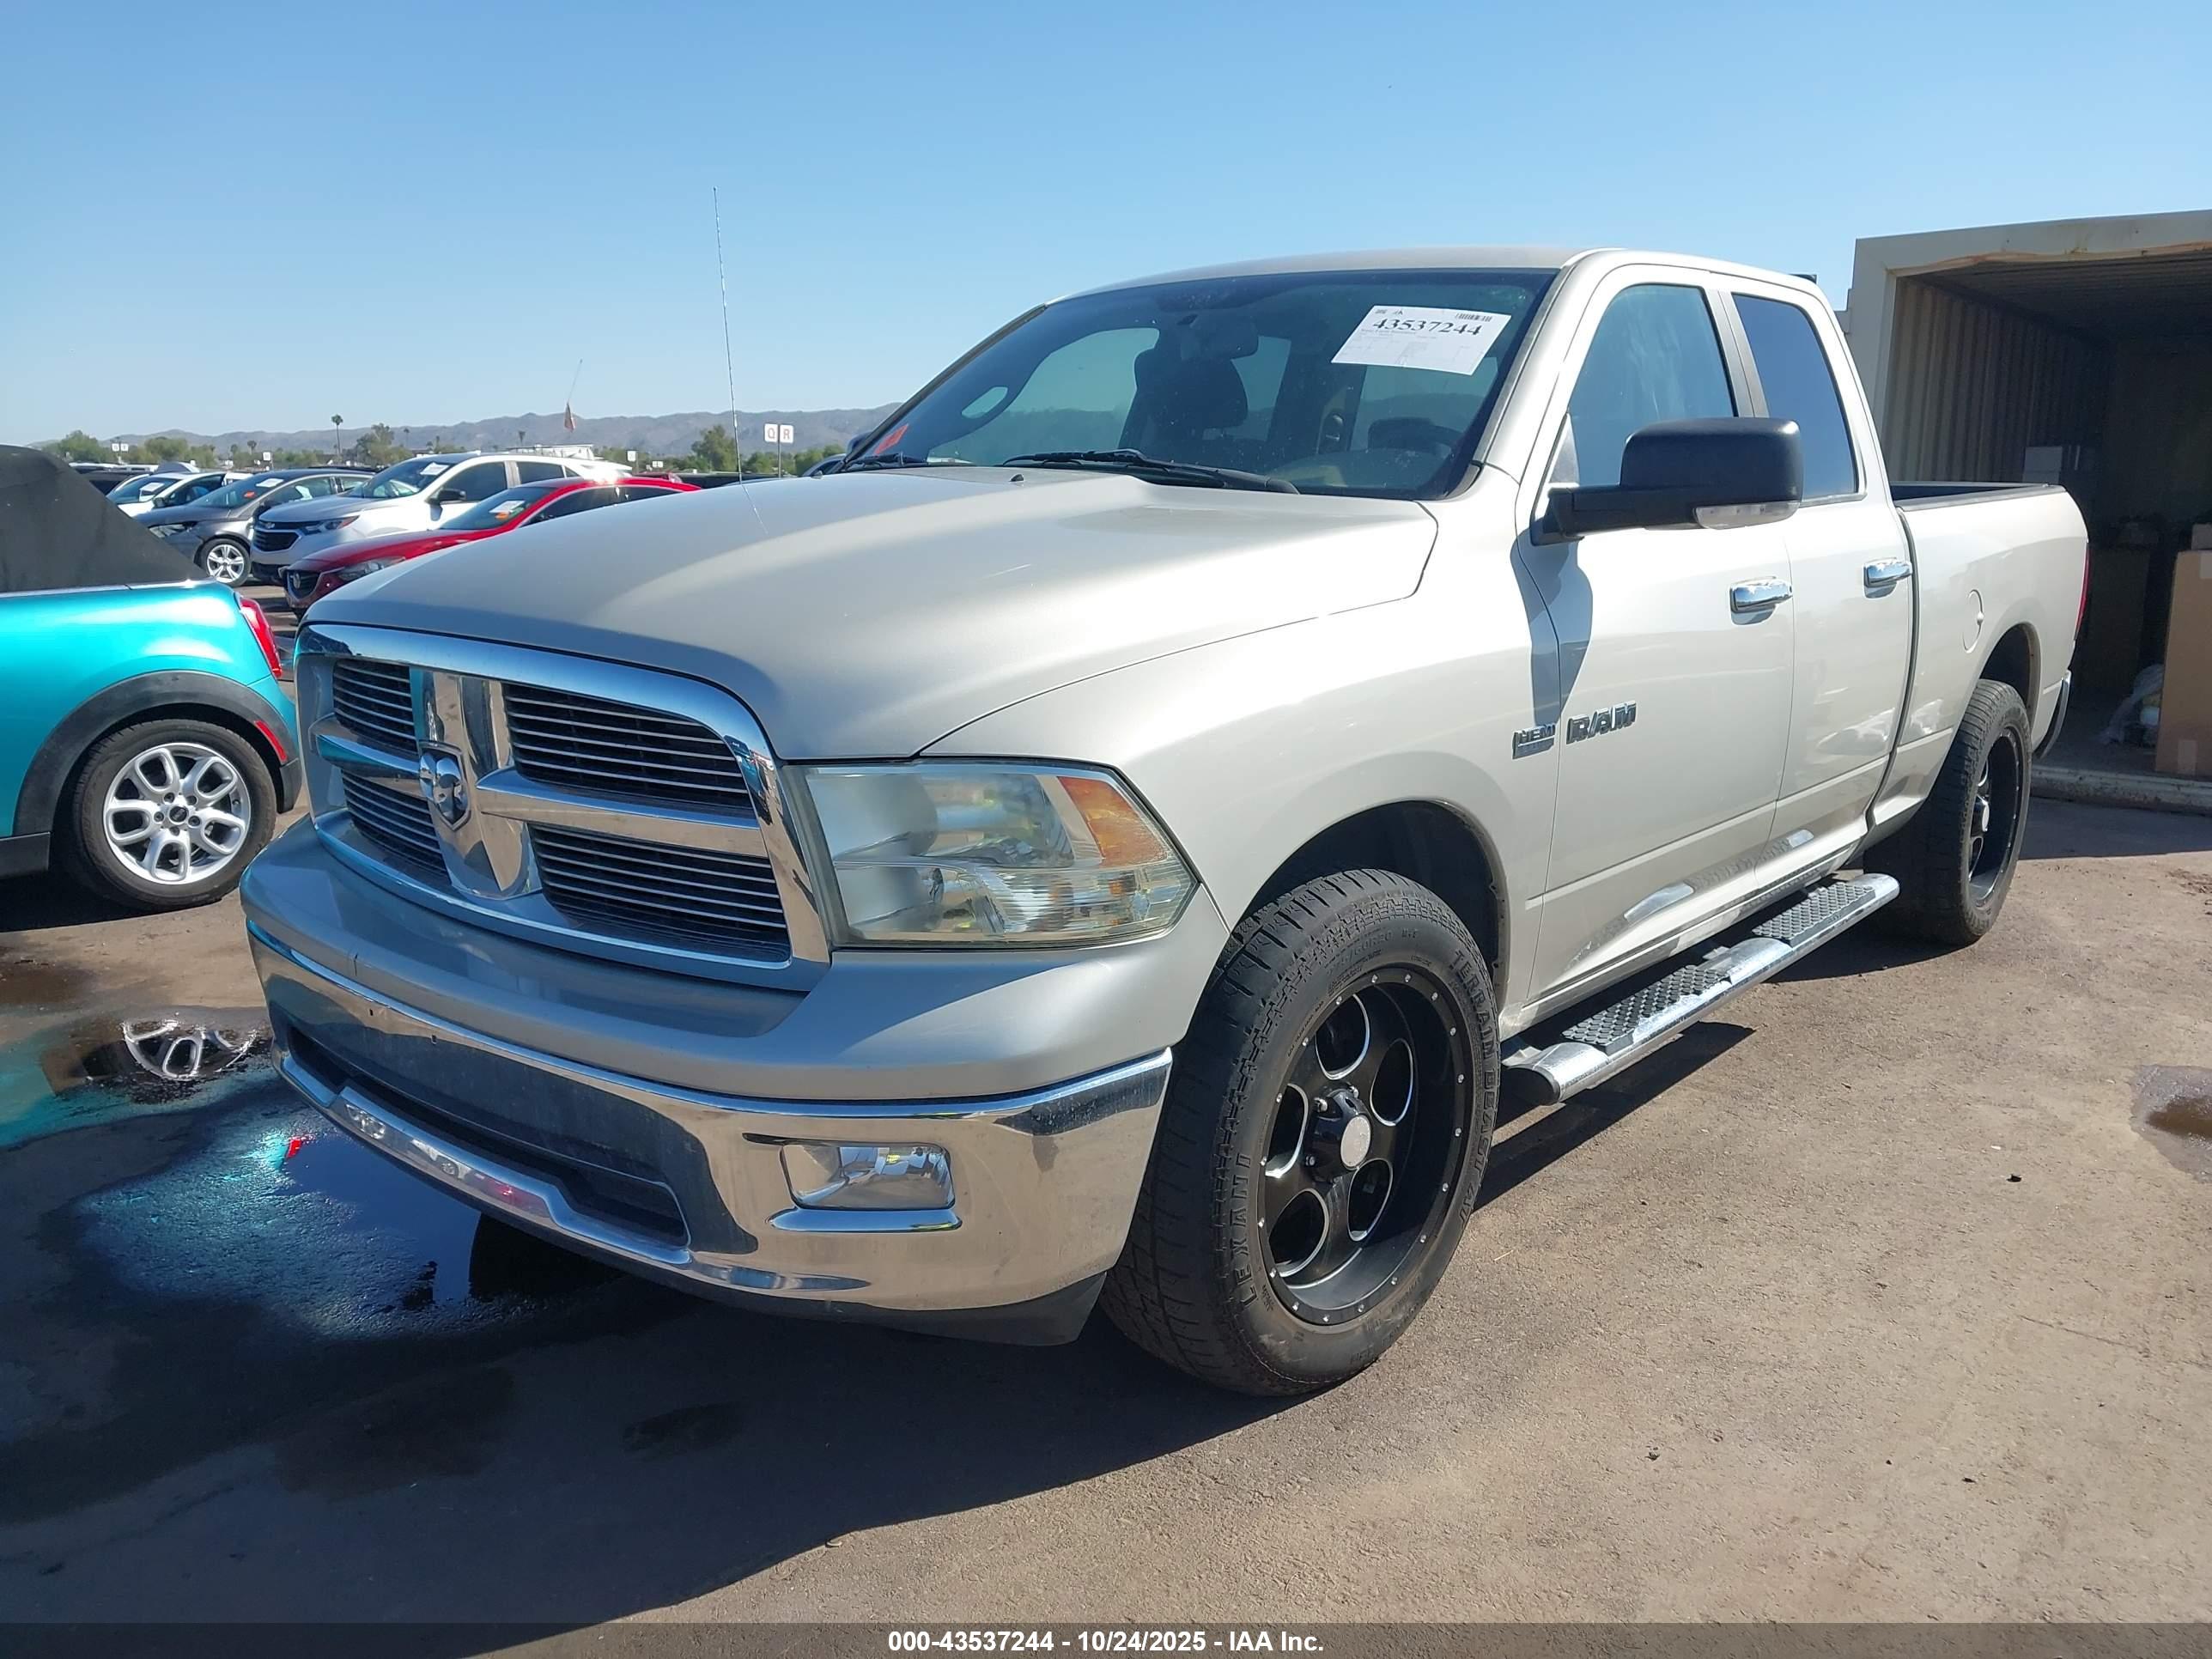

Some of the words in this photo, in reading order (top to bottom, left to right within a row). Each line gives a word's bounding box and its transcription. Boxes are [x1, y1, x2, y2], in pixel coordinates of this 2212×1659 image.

[1373, 318, 1483, 337] 43537244
[1566, 701, 1637, 744] RAM
[1231, 1152, 1259, 1309] LEXANI
